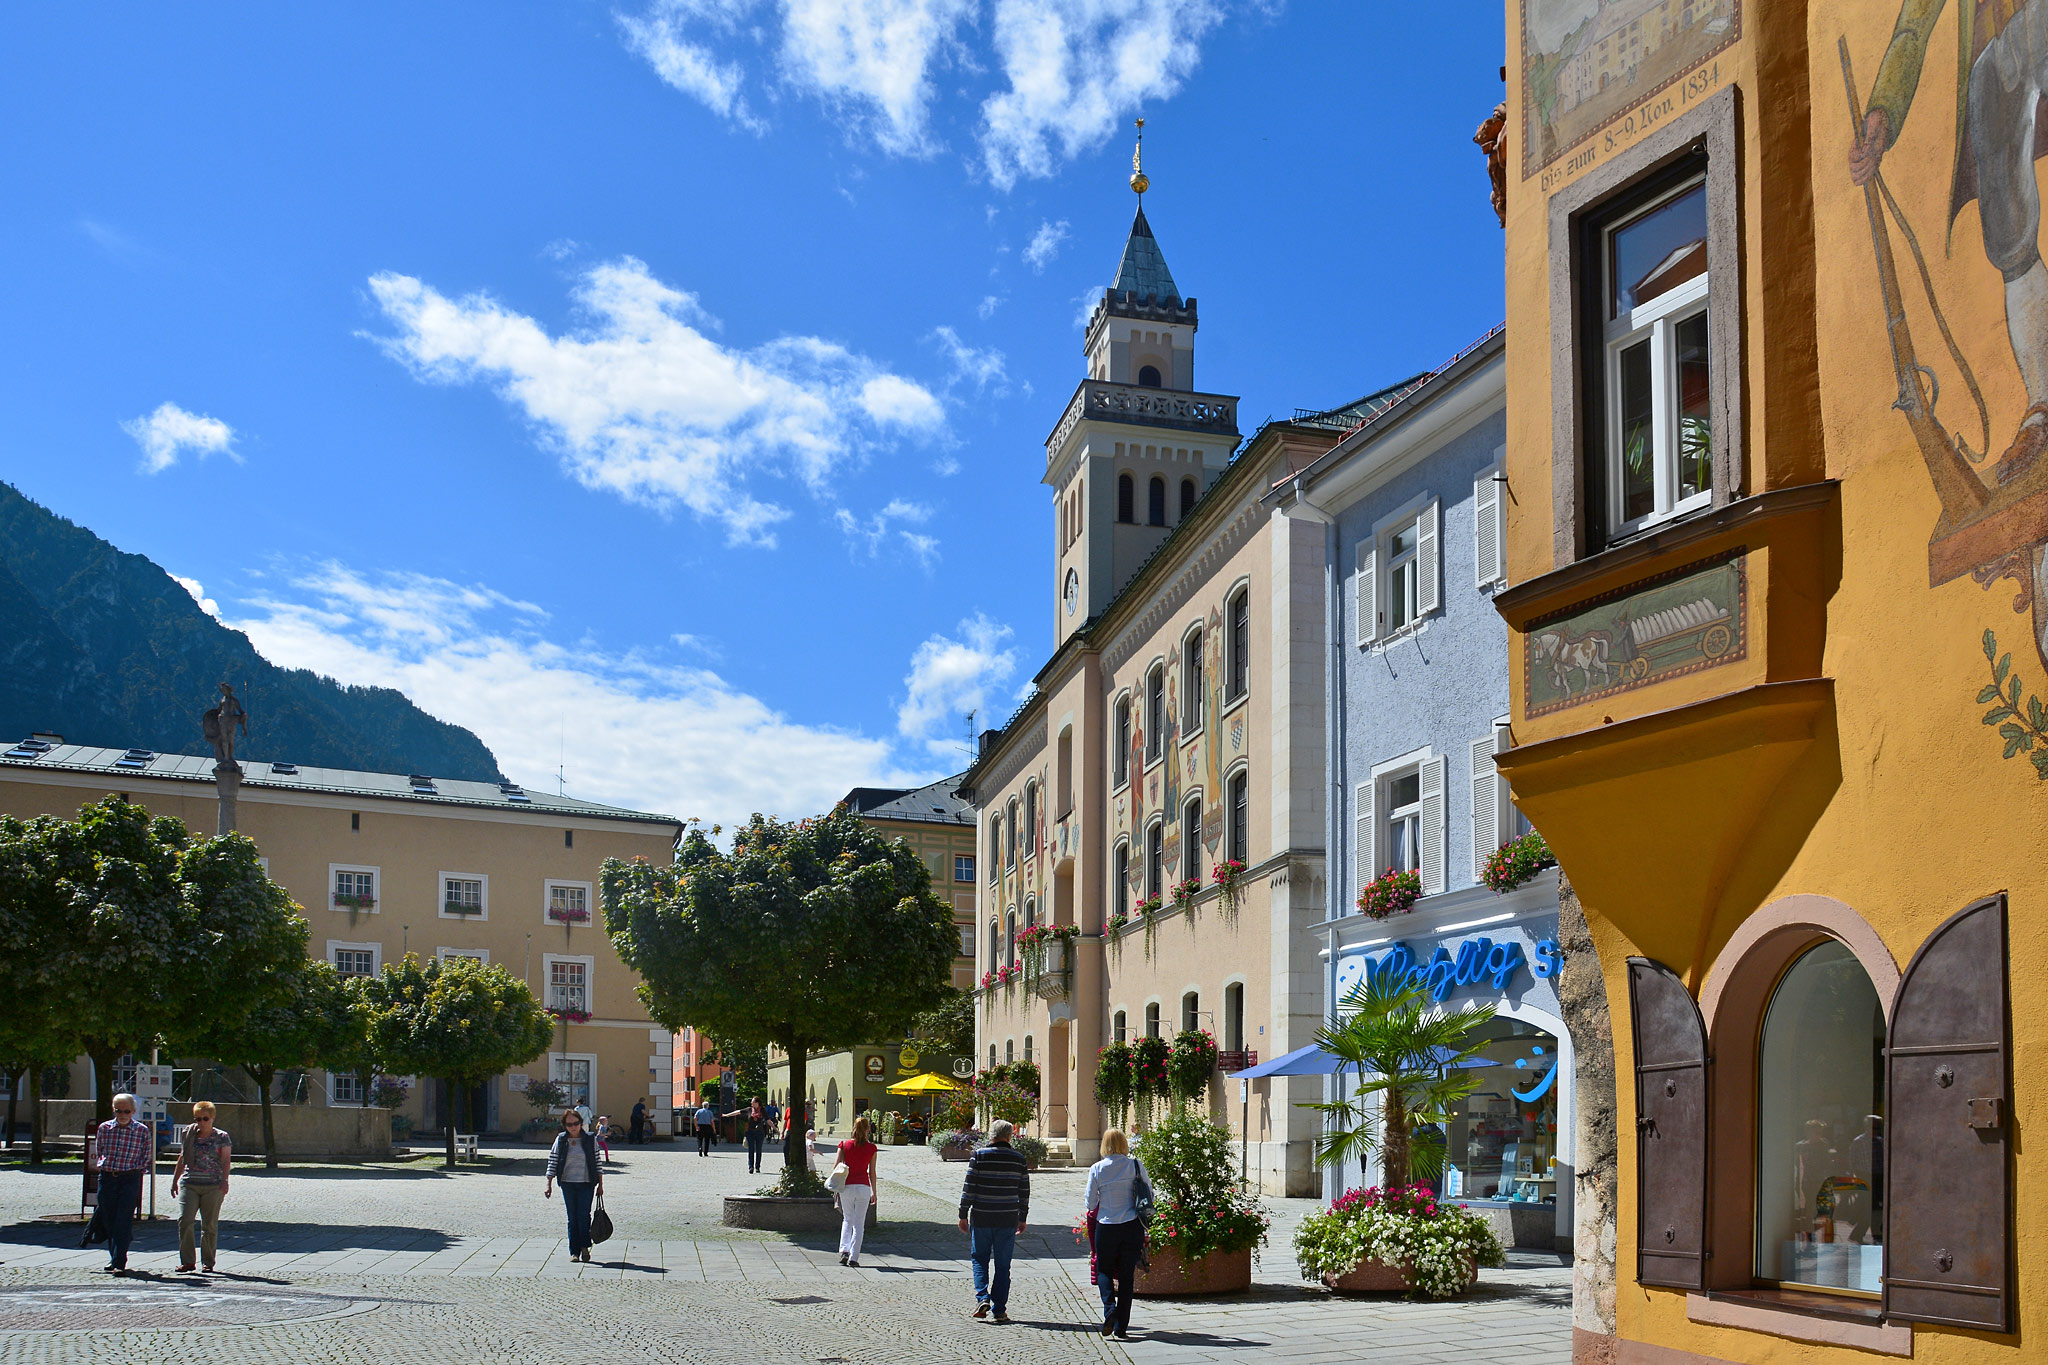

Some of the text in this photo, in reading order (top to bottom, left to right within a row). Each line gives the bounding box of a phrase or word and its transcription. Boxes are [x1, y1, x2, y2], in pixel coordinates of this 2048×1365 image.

[1541, 169, 1562, 192] bis
[1567, 146, 1597, 177] zum
[1680, 62, 1720, 107] 1834
